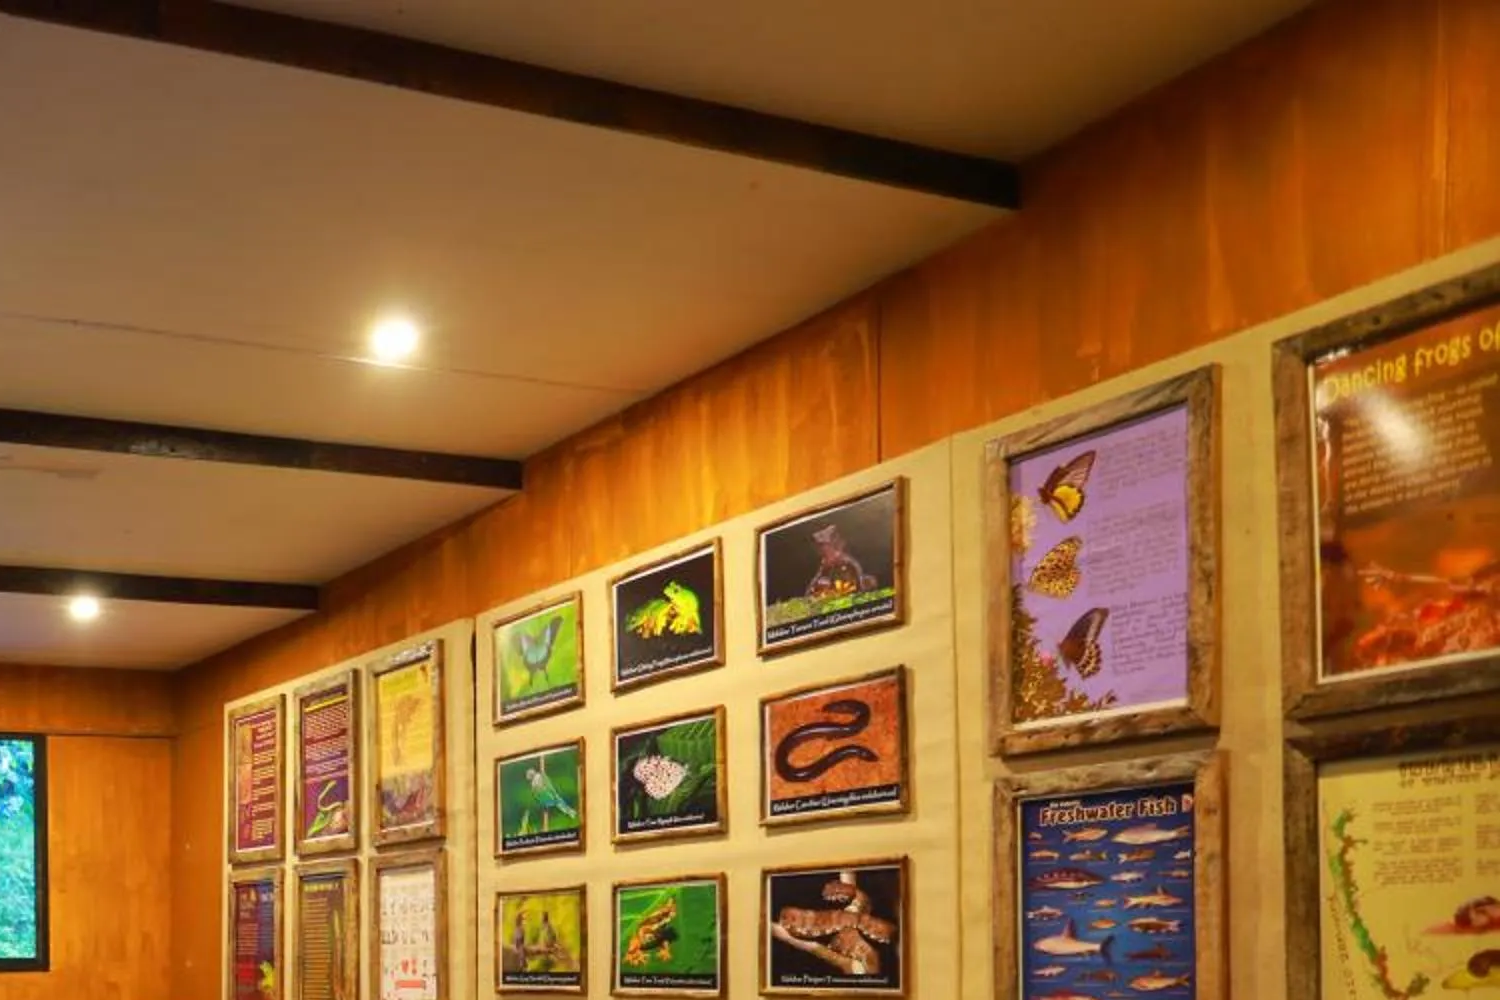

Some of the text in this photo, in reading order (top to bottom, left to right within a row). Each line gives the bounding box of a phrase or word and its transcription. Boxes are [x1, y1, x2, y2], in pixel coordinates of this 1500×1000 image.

[1323, 354, 1407, 403] Dancing
[1414, 335, 1472, 378] frogs
[1039, 801, 1135, 827] Freshwater
[1136, 795, 1178, 818] Fish
